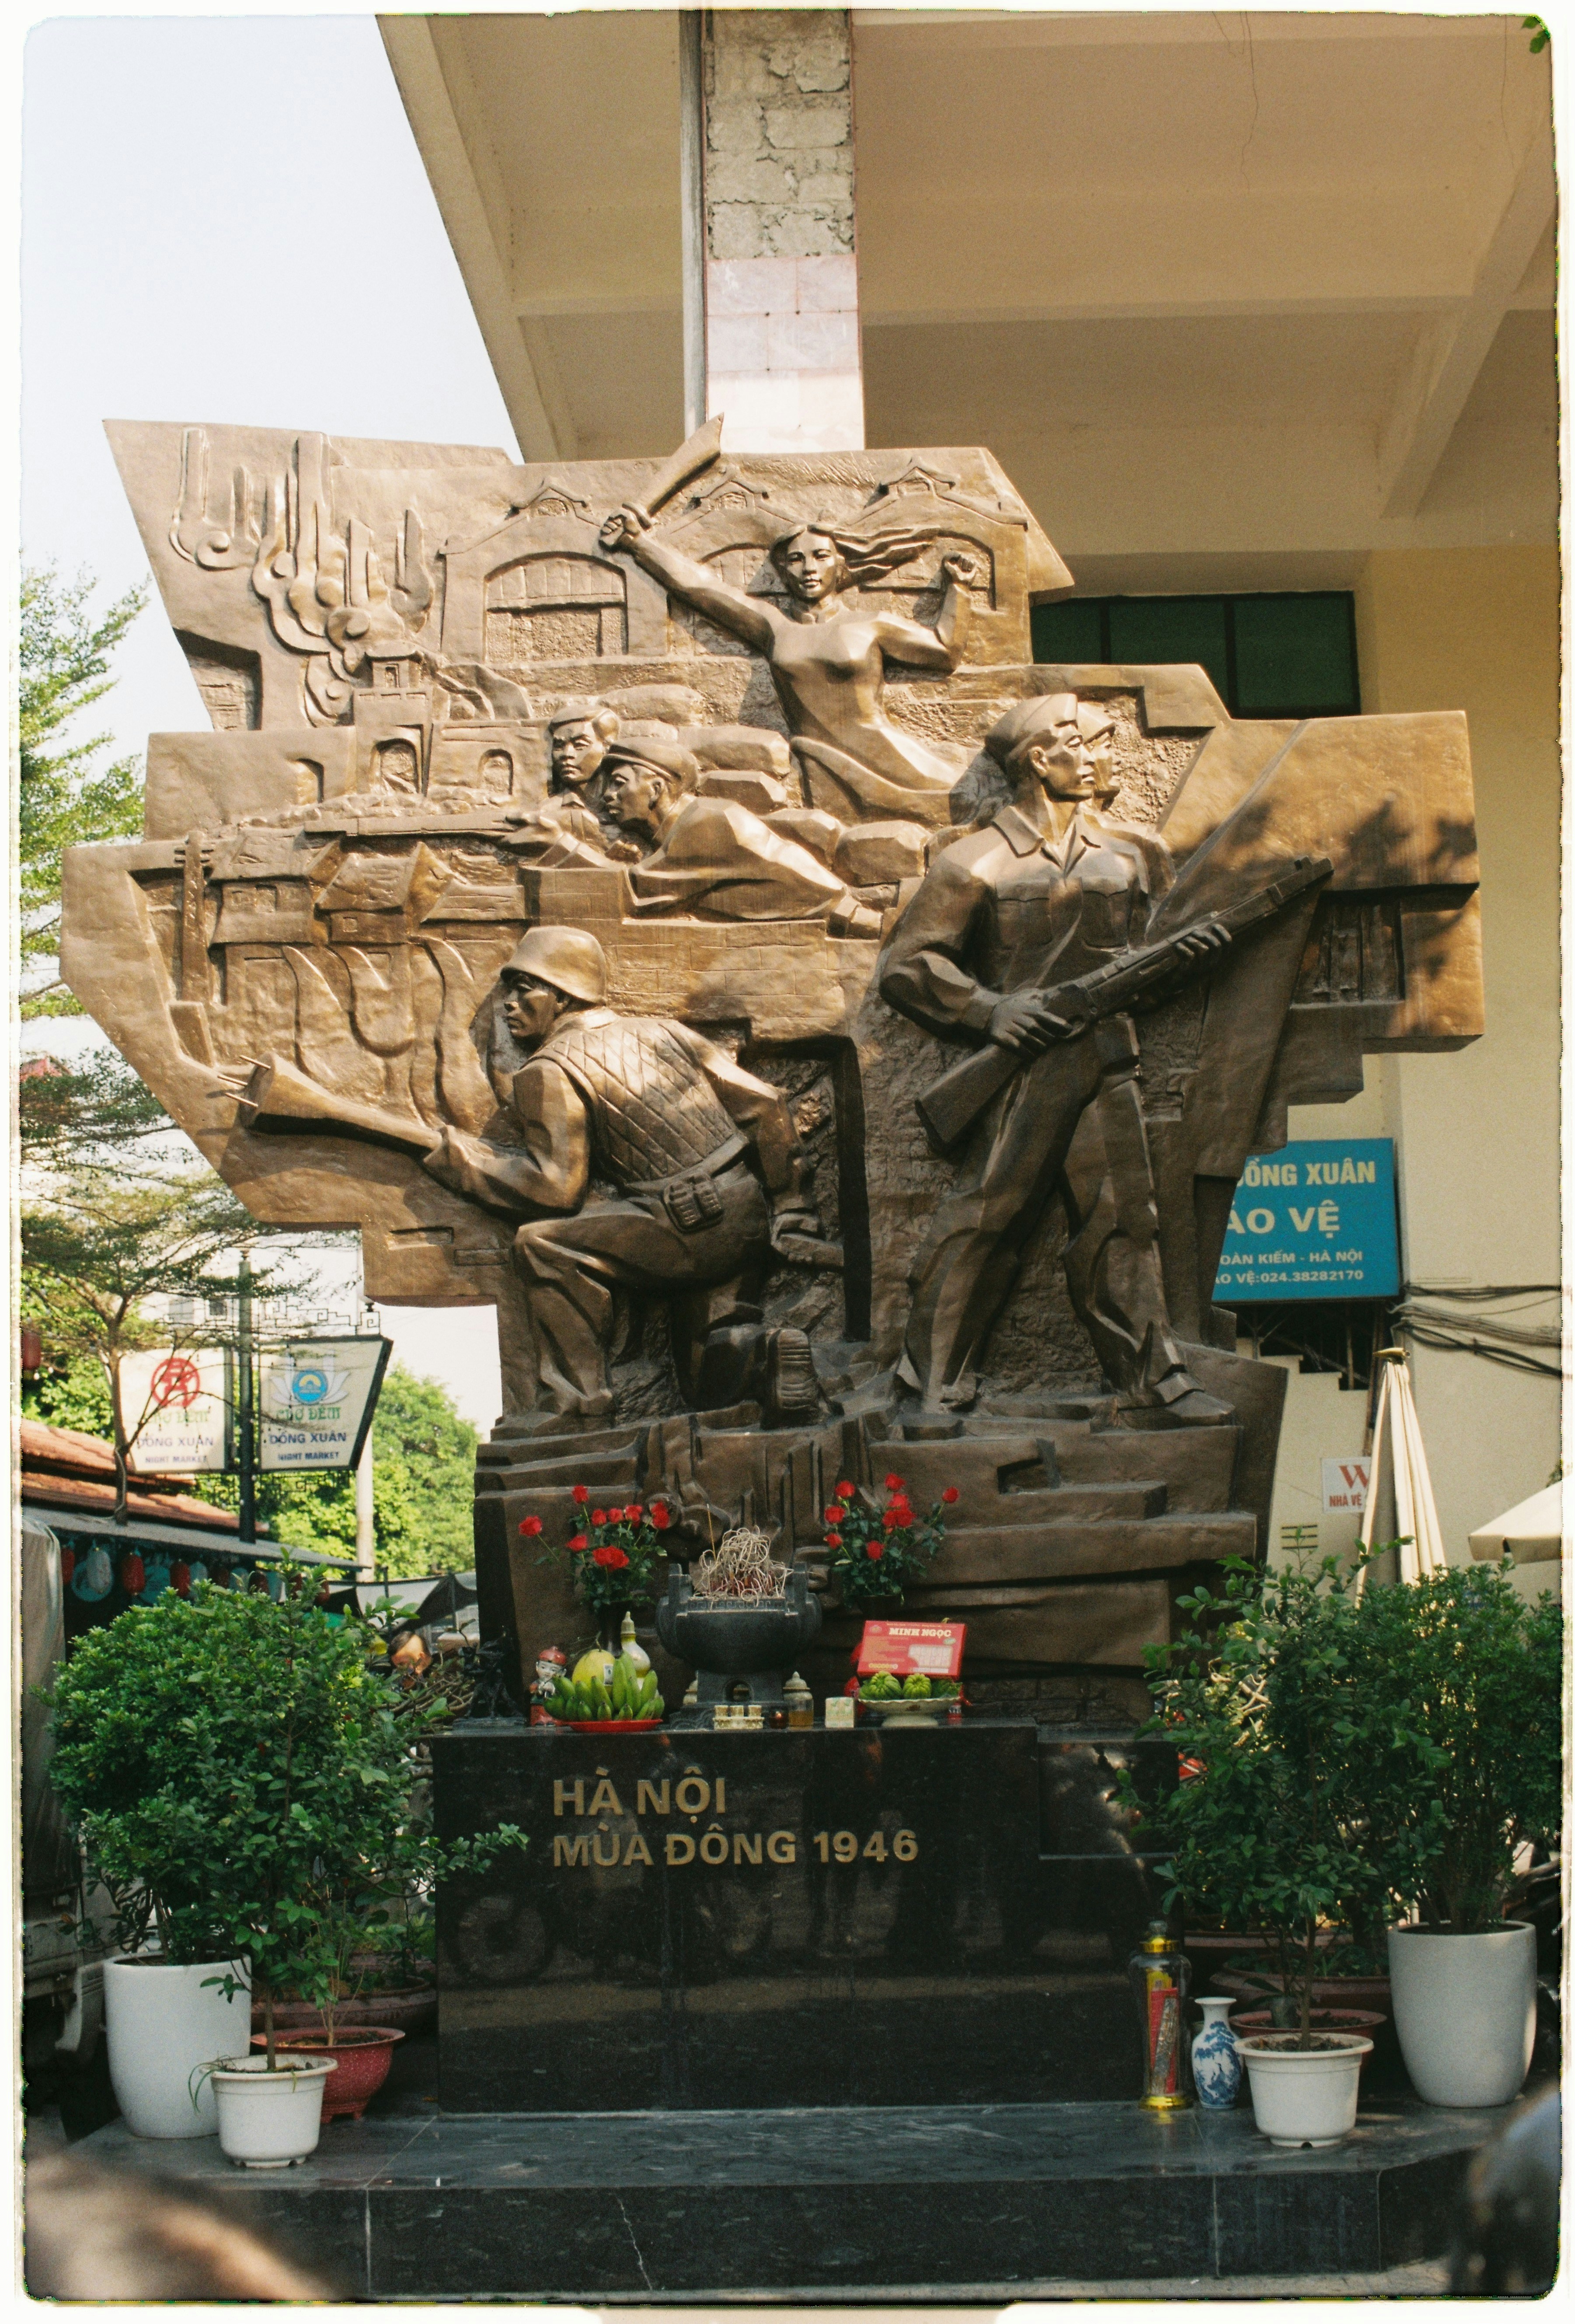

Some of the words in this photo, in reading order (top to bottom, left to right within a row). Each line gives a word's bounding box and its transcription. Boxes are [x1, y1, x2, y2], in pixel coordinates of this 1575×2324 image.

[1237, 1158, 1297, 1187] ỒNG
[1306, 1158, 1375, 1185] XUÂN
[1288, 1199, 1340, 1239] VỆ
[1258, 1249, 1295, 1264] KIẾM
[1309, 1249, 1331, 1263] HÀ
[1336, 1248, 1362, 1264] NỘI
[310, 1430, 347, 1443] XUÂN
[889, 1627, 920, 1637] MINH
[920, 1629, 951, 1639] NGỌC
[553, 1767, 624, 1816] HÀ
[637, 1766, 726, 1824] NỘI
[553, 1822, 655, 1867] MÙA
[664, 1823, 797, 1866] ĐÔNG
[813, 1829, 920, 1863] 1946
